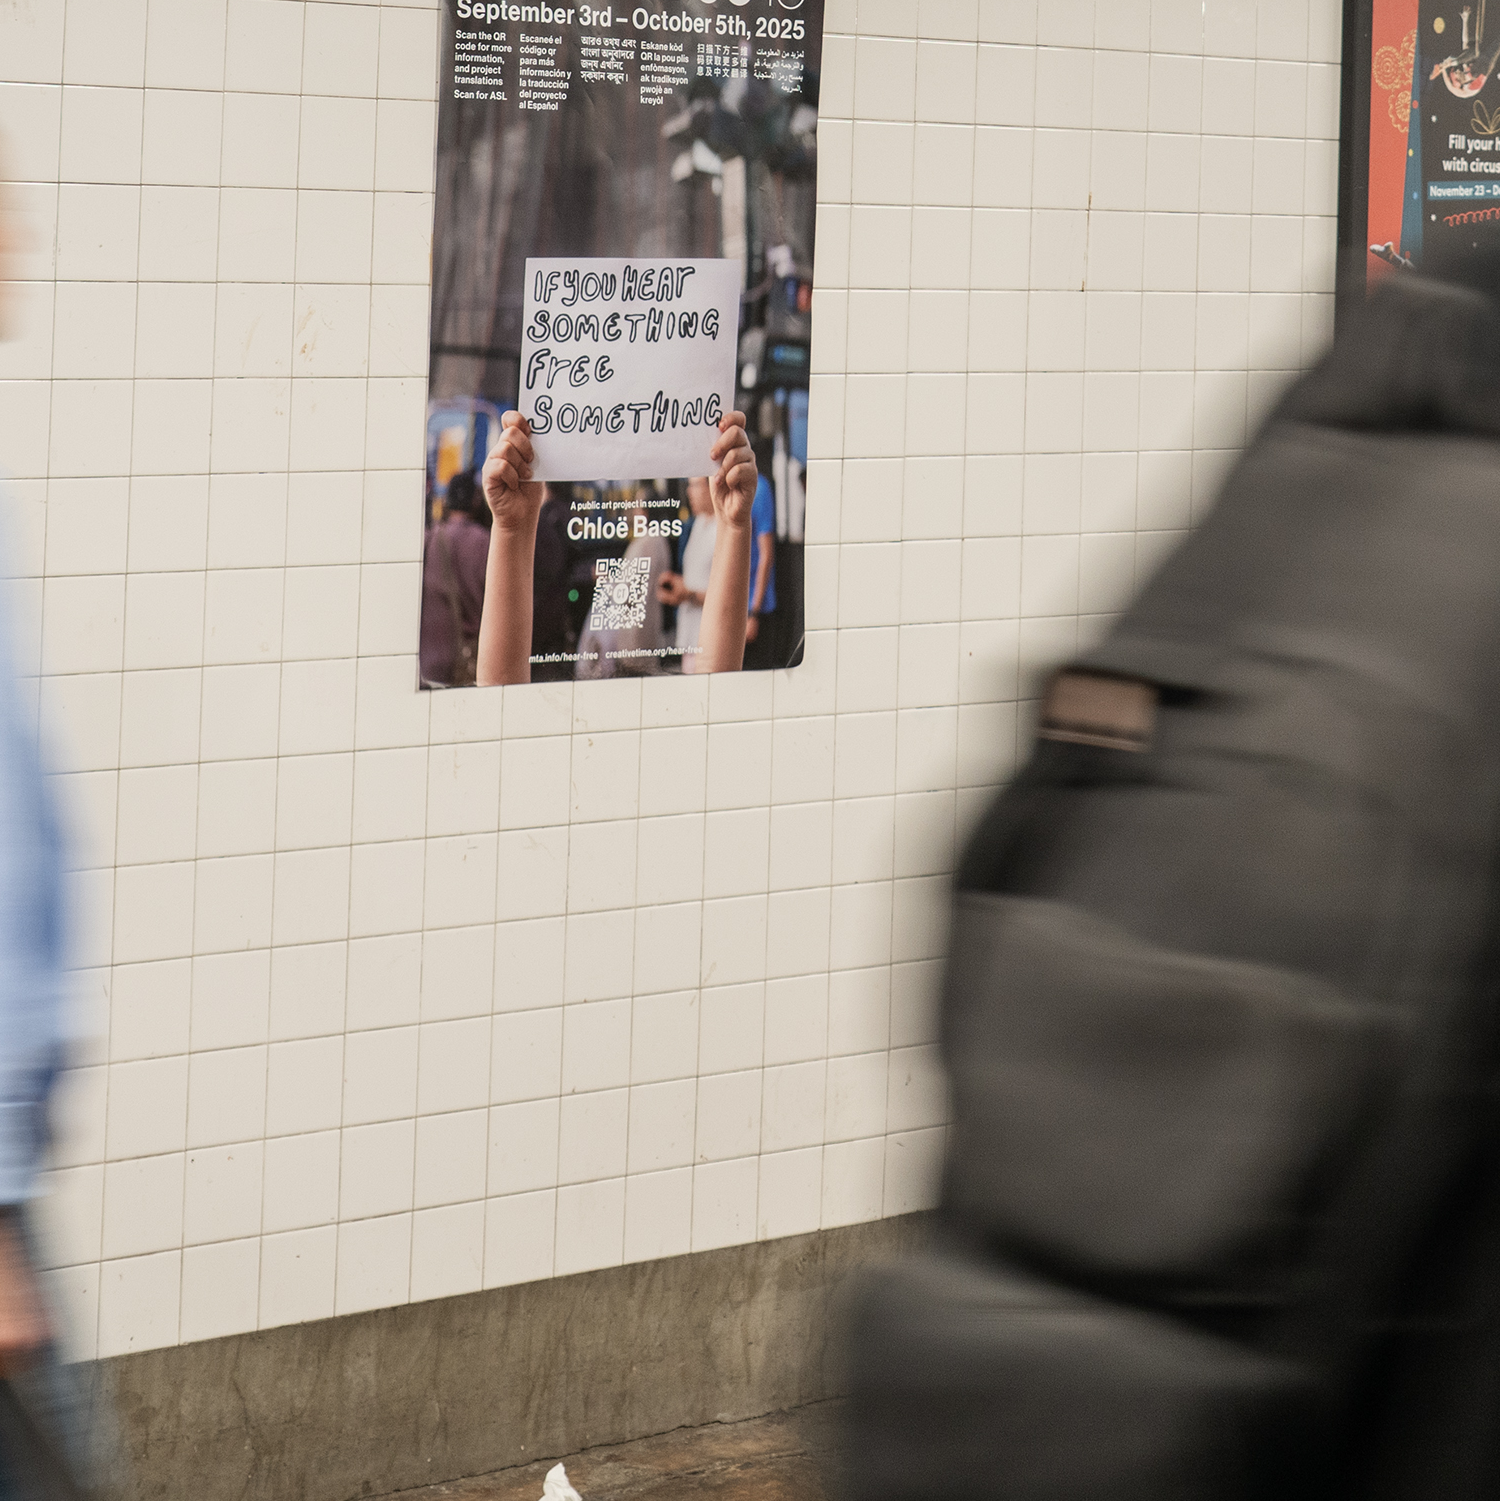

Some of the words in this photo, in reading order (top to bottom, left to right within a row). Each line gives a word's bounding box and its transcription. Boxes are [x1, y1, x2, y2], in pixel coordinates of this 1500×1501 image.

[579, 5, 612, 27] 3rd
[632, 8, 711, 33] October
[716, 15, 751, 40] 5th,
[756, 17, 805, 39] 2025
[456, 30, 476, 39] Scan
[479, 32, 492, 40] the
[493, 32, 506, 41] QR
[520, 34, 553, 44] Escaneé
[555, 36, 562, 44] el
[478, 42, 489, 51] for
[520, 46, 547, 55] código
[548, 48, 556, 56] qr
[641, 41, 668, 50] Eskane
[670, 43, 683, 51] kòd
[455, 53, 504, 64] information,
[520, 58, 537, 66] para
[539, 58, 554, 66] más
[641, 52, 652, 61] QR
[654, 53, 660, 61] la
[677, 55, 689, 63] plis
[455, 64, 470, 73] and
[471, 65, 501, 75] project
[520, 67, 565, 77] información
[567, 71, 571, 79] y
[641, 64, 686, 74] enfòmasyon,
[455, 75, 503, 85] translations
[520, 78, 526, 86] la
[528, 79, 569, 89] traducción
[641, 74, 650, 82] ak
[652, 75, 688, 85] tradiksyon
[454, 90, 474, 99] Scan
[476, 91, 488, 100] for
[490, 92, 507, 100] ASL
[519, 90, 531, 98] del
[533, 91, 567, 100] proyecto
[641, 85, 662, 95] pwojè
[519, 101, 526, 109] al
[528, 102, 558, 111] Español
[641, 96, 663, 106] kreyòl
[1449, 134, 1466, 149] Fill
[1467, 139, 1493, 154] your
[1442, 157, 1468, 172] with
[1429, 185, 1474, 196] November
[1474, 185, 1484, 195] 23
[527, 307, 720, 343] SOMETHING
[527, 391, 722, 435] SOMETHING
[570, 501, 577, 510] A
[578, 501, 600, 511] public
[602, 500, 611, 509] art
[613, 500, 639, 511] project
[640, 499, 647, 508] in
[648, 499, 670, 507] sound
[671, 499, 680, 508] by
[567, 516, 628, 540] Chloë
[634, 515, 682, 537] Bass
[529, 651, 598, 663] mta.info/hear-free
[605, 645, 703, 659] creativetime.org/hear-free
